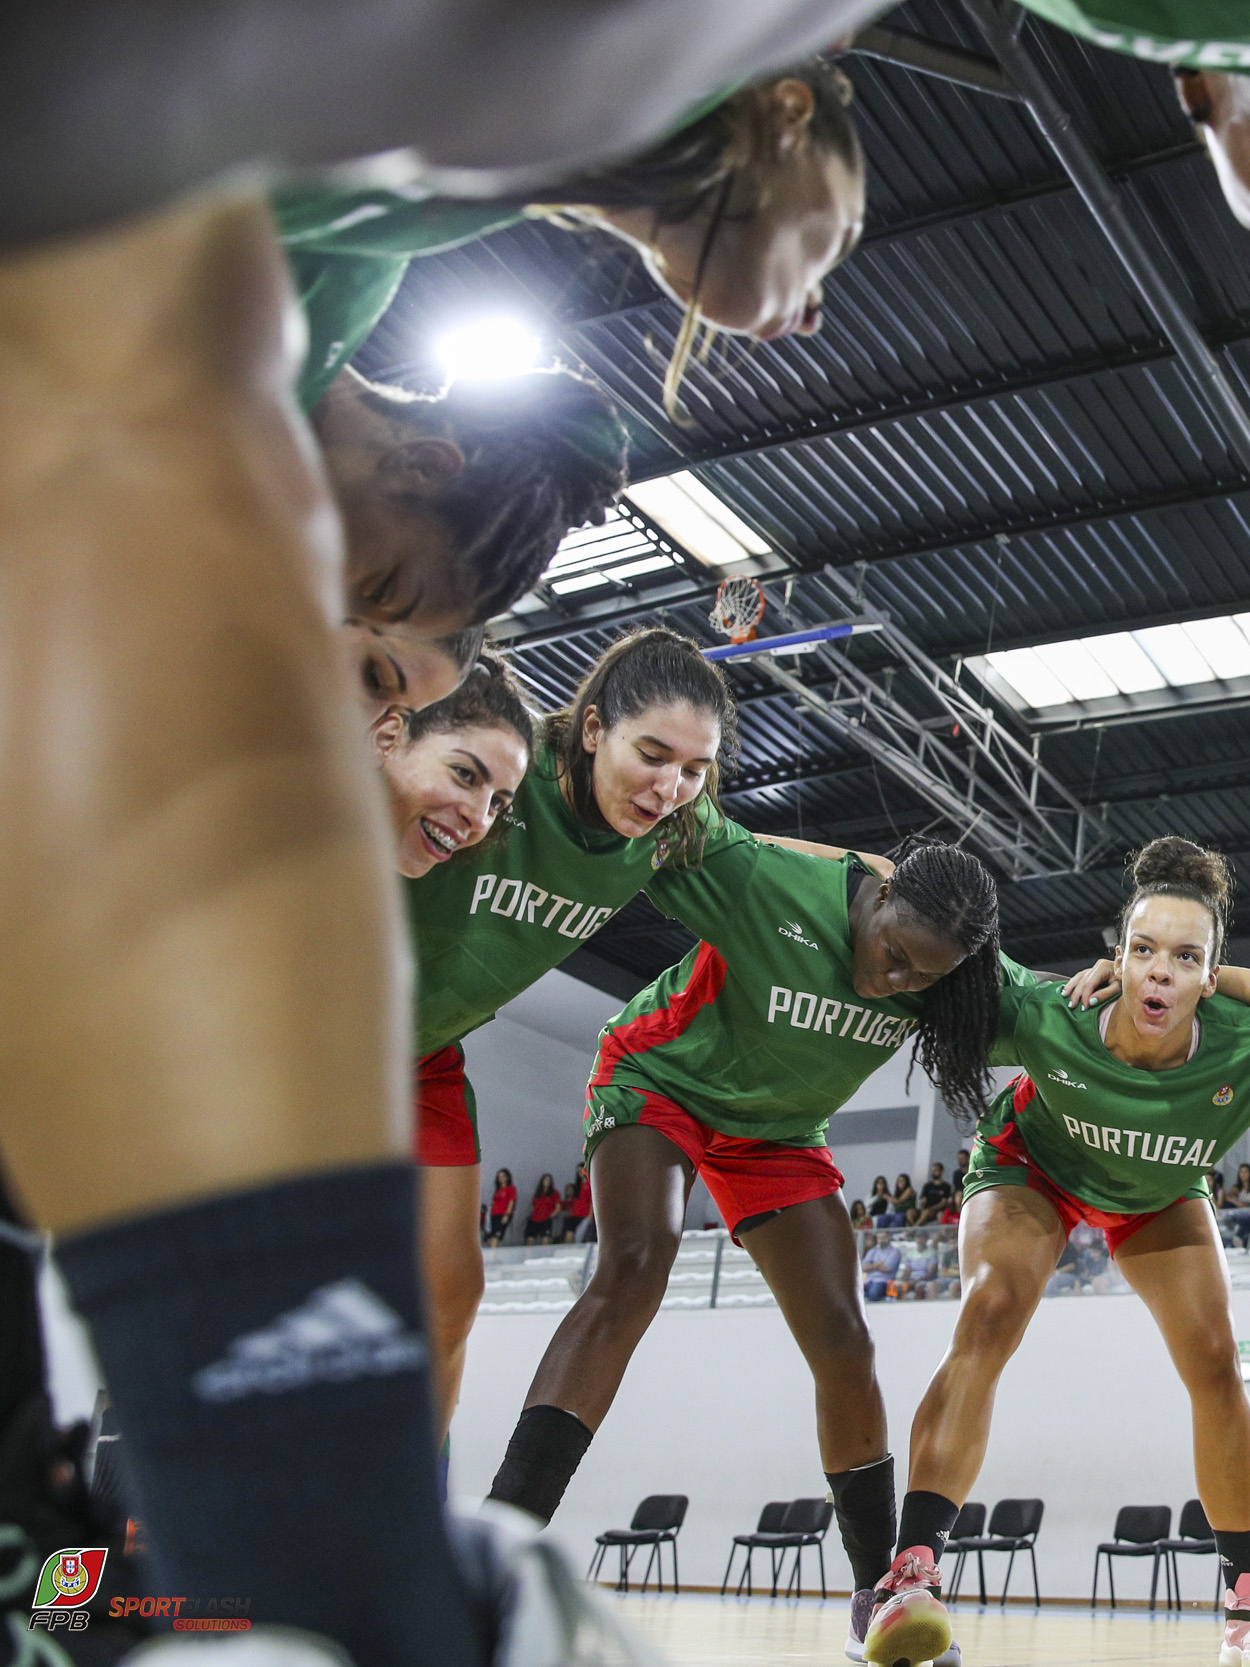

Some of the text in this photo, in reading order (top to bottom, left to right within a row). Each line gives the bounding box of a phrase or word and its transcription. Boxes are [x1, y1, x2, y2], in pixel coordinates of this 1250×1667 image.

[778, 926, 819, 951] DHIKA
[1047, 1072, 1088, 1091] DHIKA
[1062, 1113, 1217, 1168] PORTUGAL
